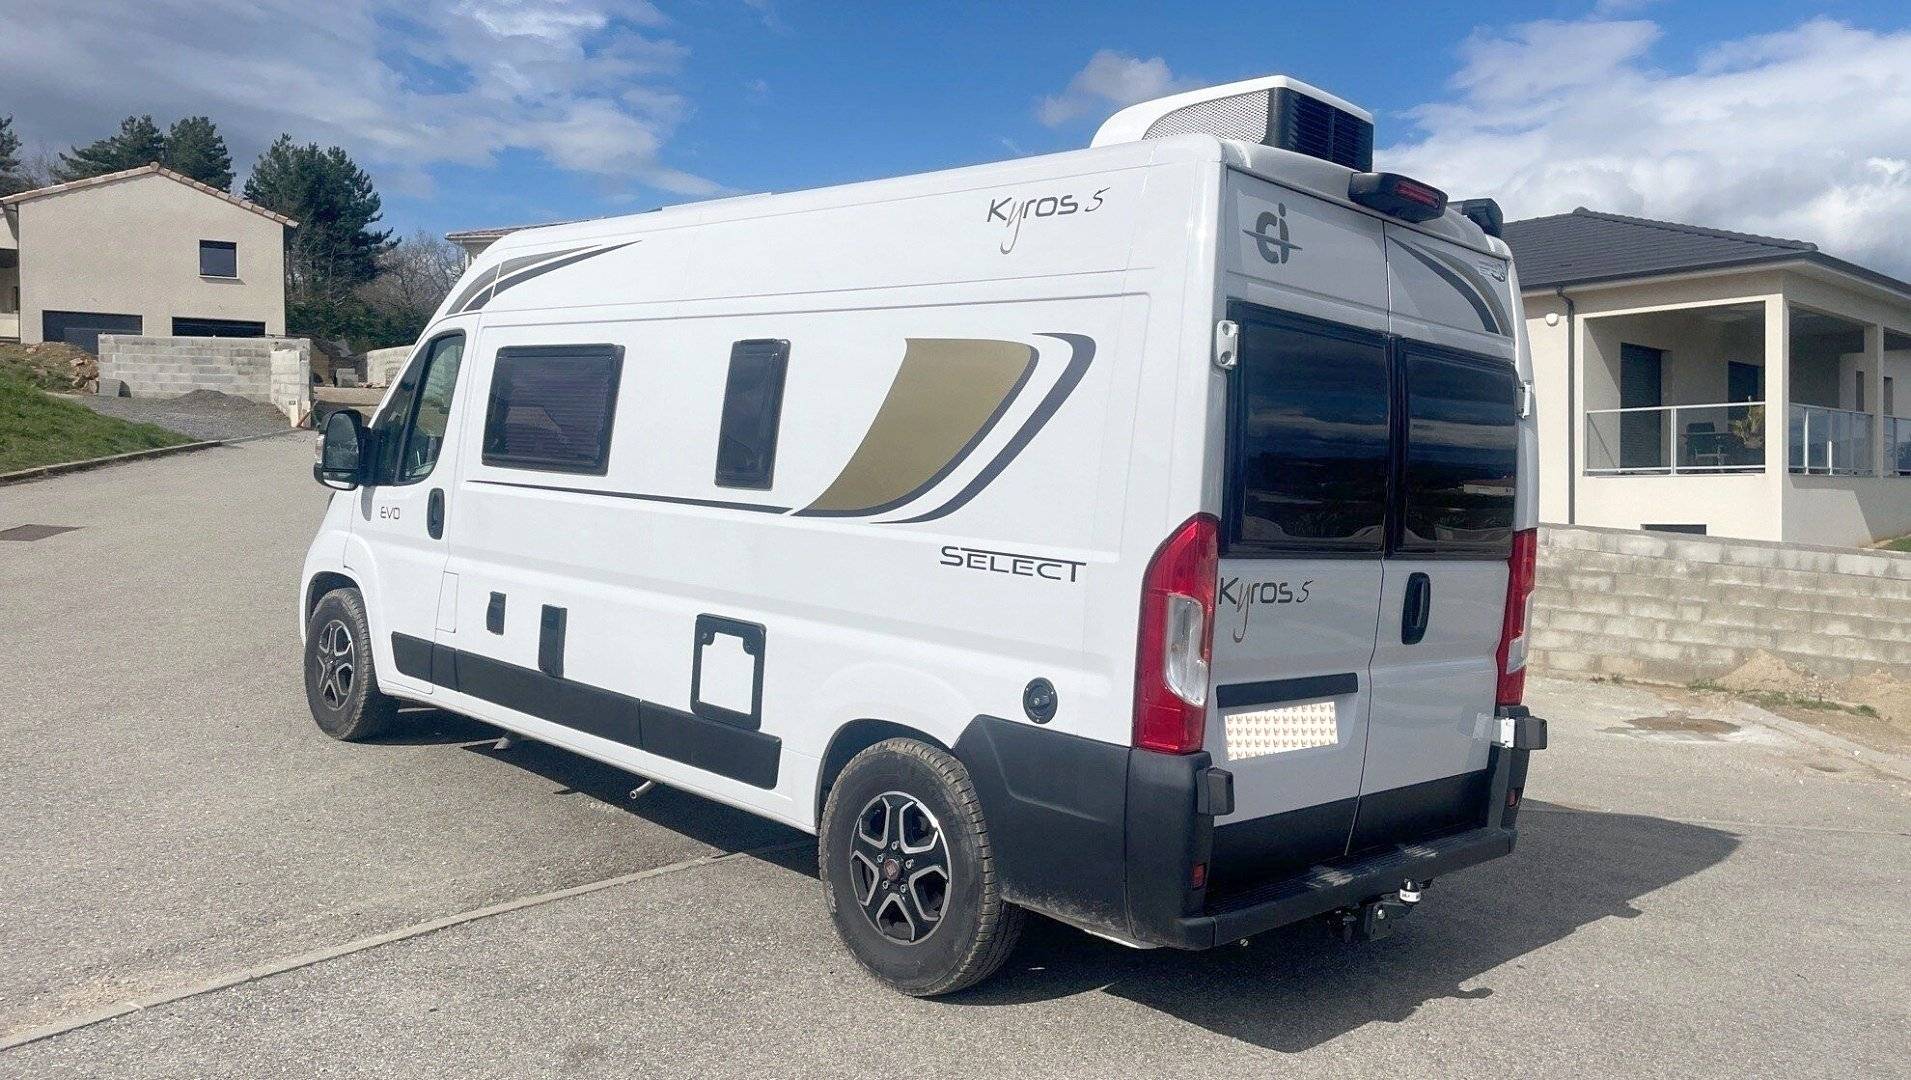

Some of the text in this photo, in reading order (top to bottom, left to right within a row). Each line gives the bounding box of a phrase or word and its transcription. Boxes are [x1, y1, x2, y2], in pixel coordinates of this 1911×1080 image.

[986, 186, 1111, 255] Kyros 5
[380, 506, 400, 520] EVO
[940, 545, 1087, 583] SELECT
[1218, 577, 1314, 643] Kyros 5
